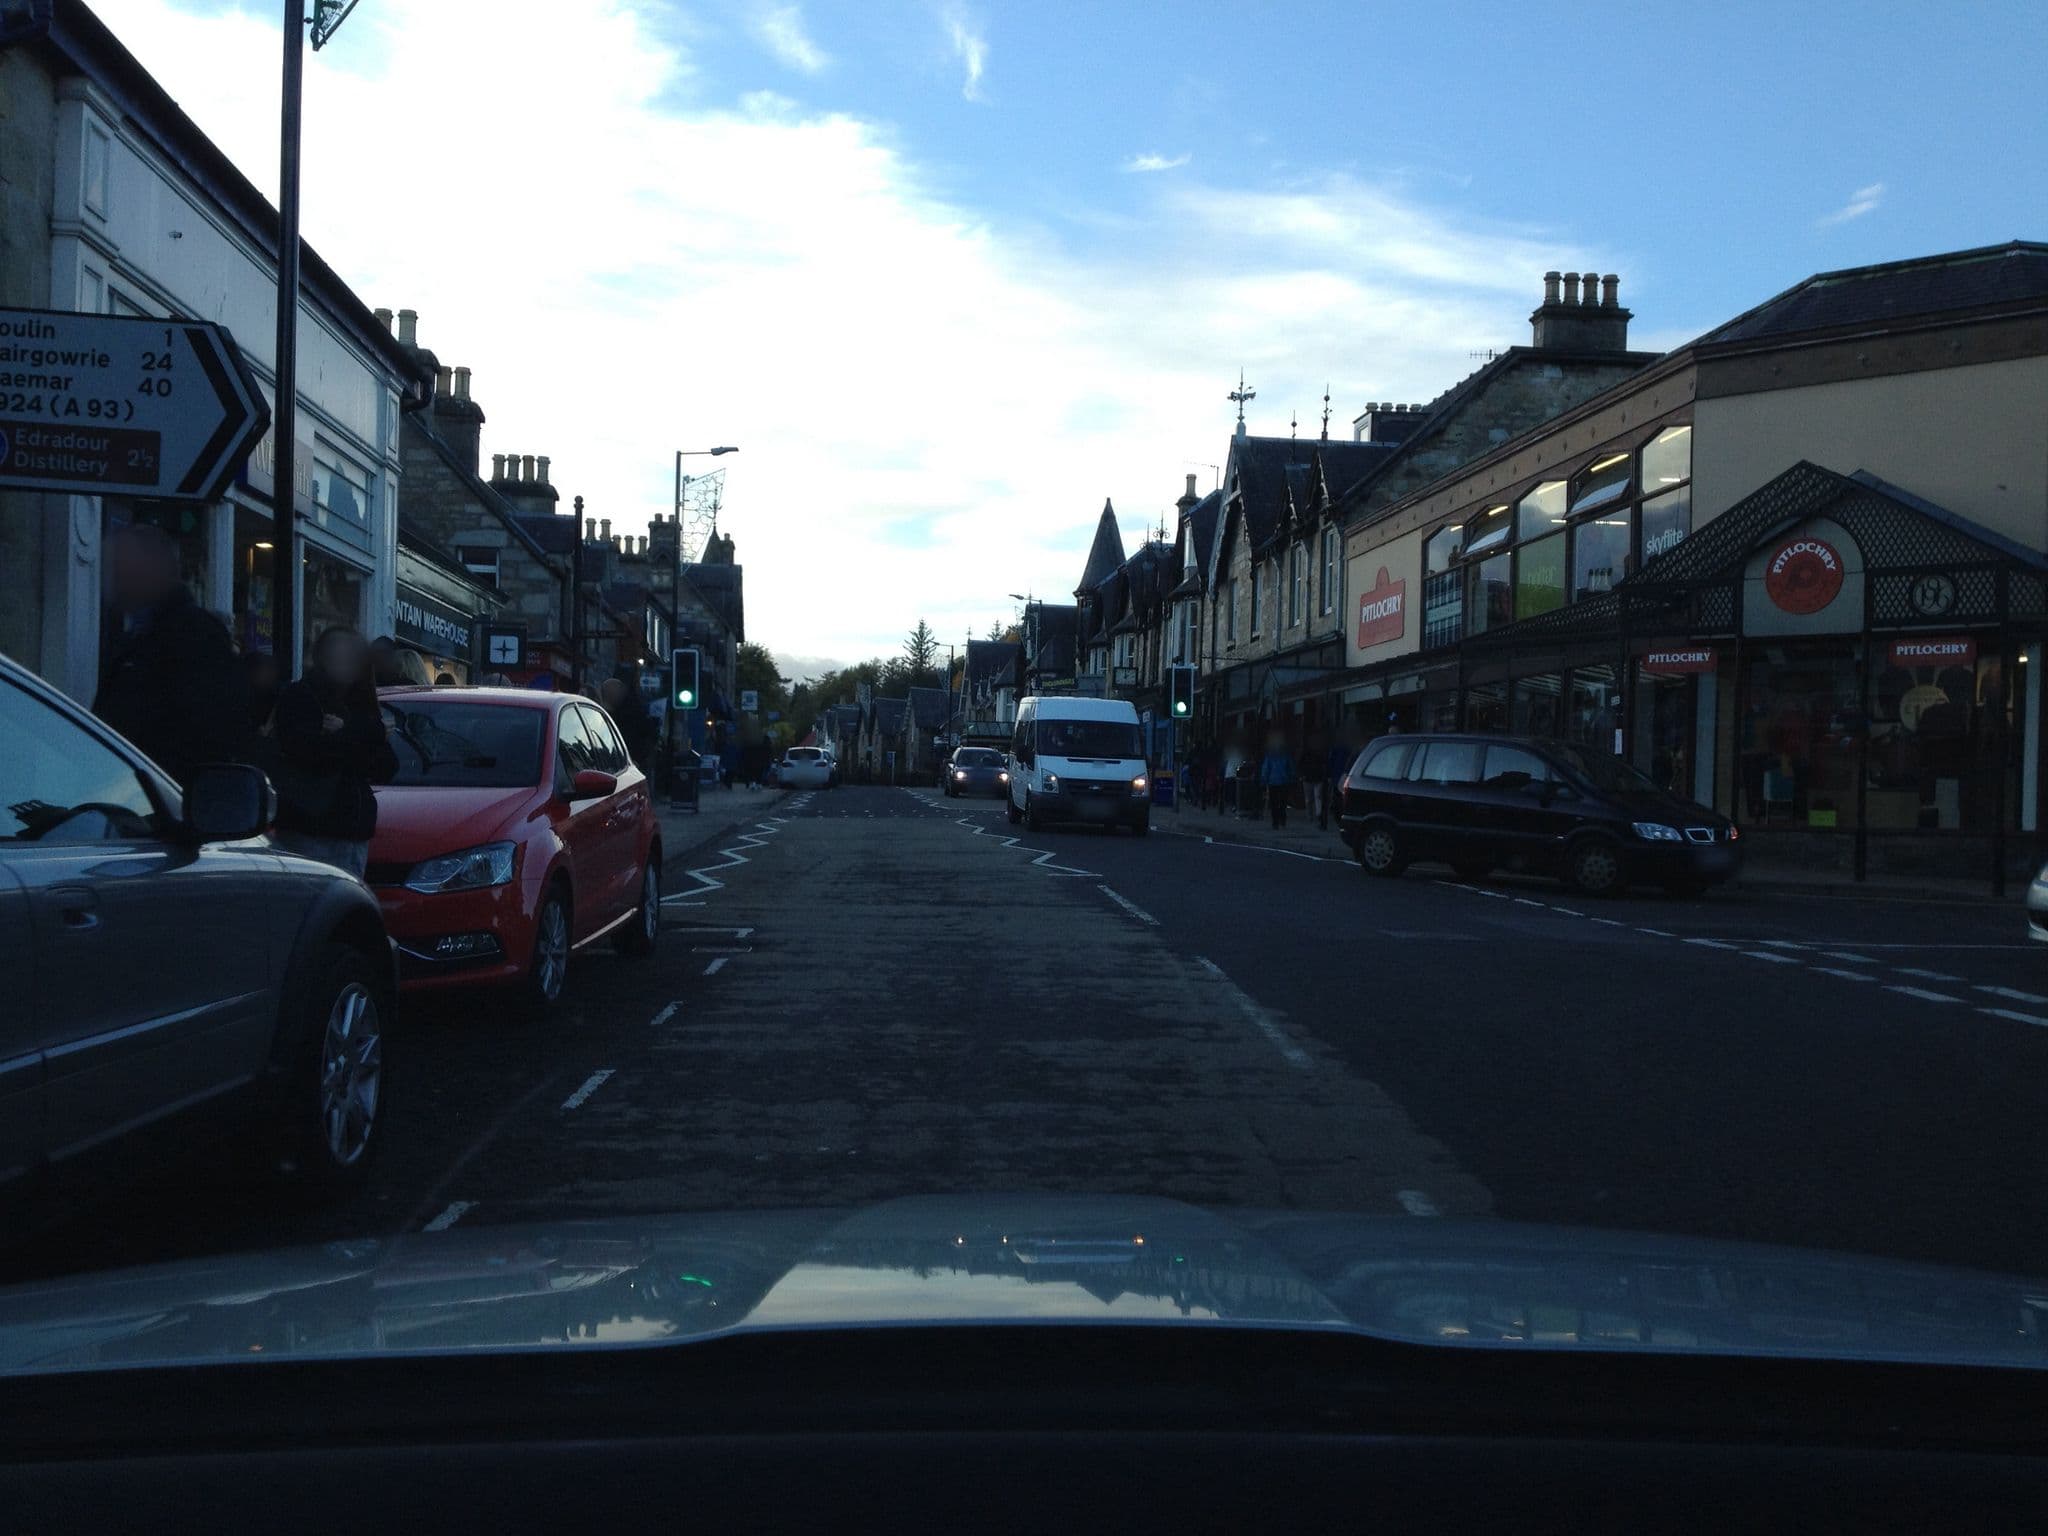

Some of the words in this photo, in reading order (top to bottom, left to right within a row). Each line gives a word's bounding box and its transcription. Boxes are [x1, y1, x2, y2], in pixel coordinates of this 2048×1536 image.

[0, 319, 56, 339] oulin
[164, 328, 173, 347] 1
[0, 344, 112, 369] airgowrie
[142, 351, 173, 371] 24
[0, 371, 74, 391] aemar
[138, 377, 173, 397] 40
[15, 428, 111, 450] Edradour
[15, 451, 109, 476] Distillery
[1772, 543, 1838, 574] PITLOCHRY
[1362, 593, 1402, 624] PITLOCHRY
[423, 610, 469, 648] WAREHOUSE
[1648, 651, 1712, 664] PITLOCHRY
[1896, 643, 1969, 656] PITLOCHRY
